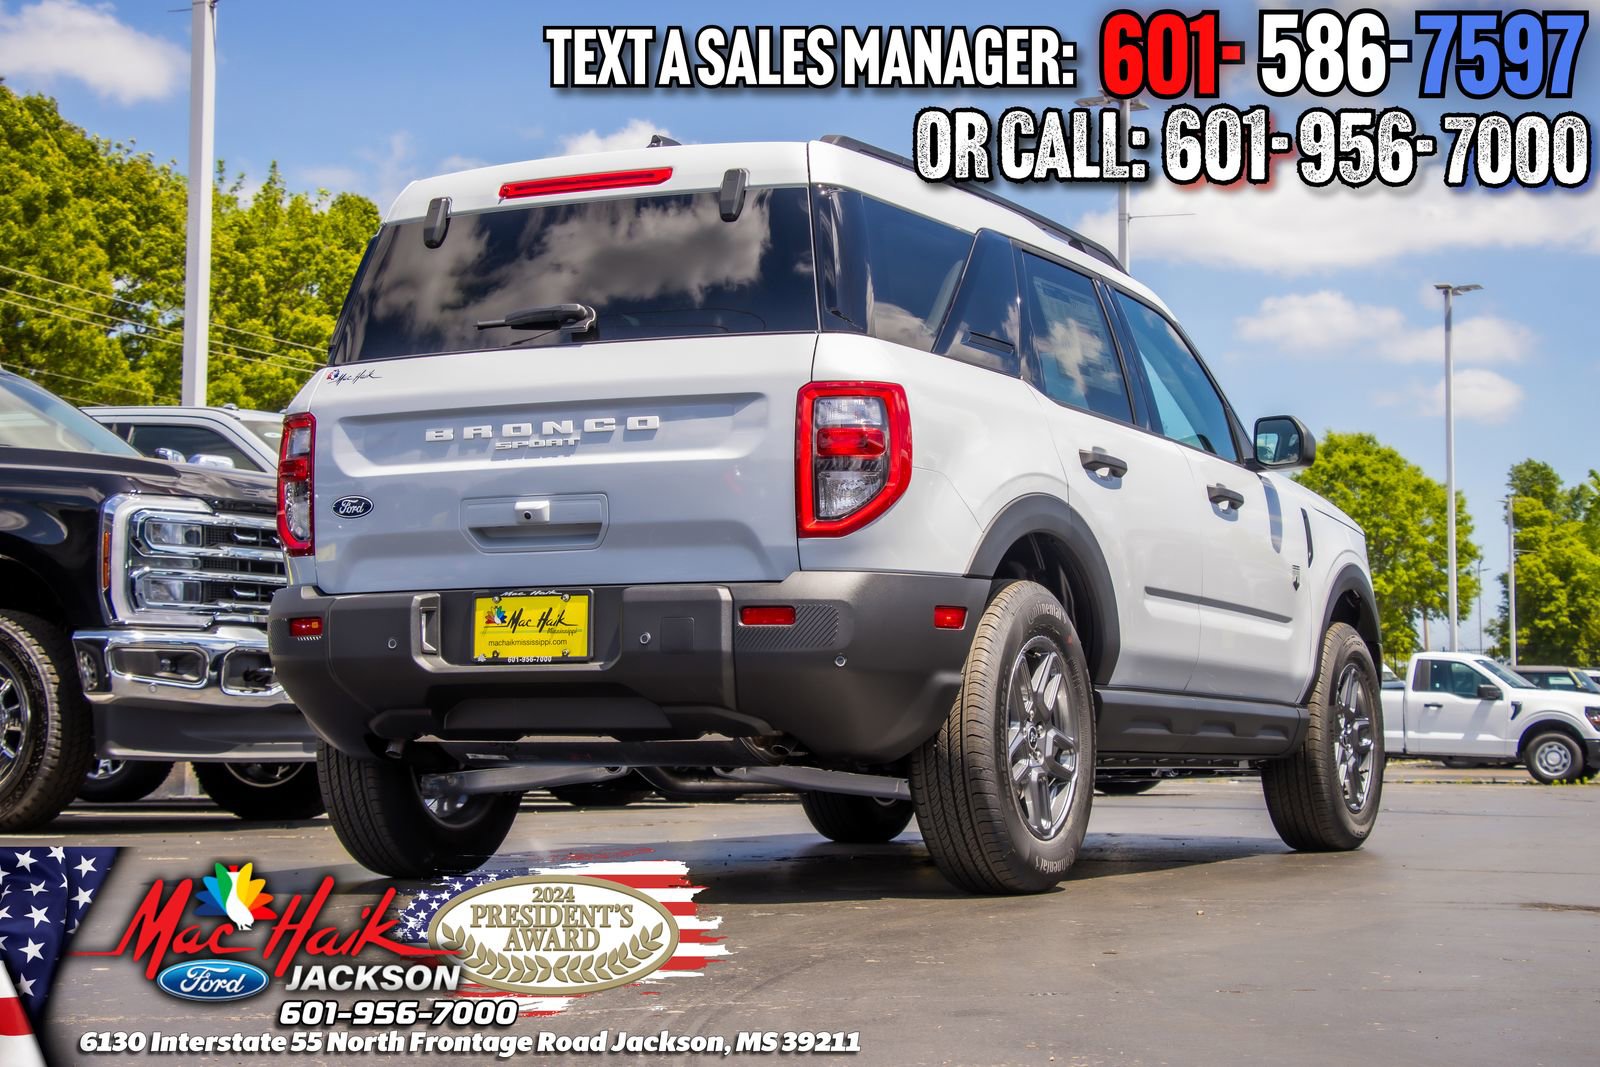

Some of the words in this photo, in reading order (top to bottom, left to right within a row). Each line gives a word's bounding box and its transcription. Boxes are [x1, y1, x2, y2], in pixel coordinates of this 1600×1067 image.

[425, 415, 660, 442] BRONCO
[495, 437, 581, 450] SPORT
[337, 497, 368, 515] Ford
[498, 608, 532, 633] Mac
[534, 607, 576, 633] Haik
[547, 627, 577, 636] Mississippi
[488, 638, 568, 647] machaikmississippi.com
